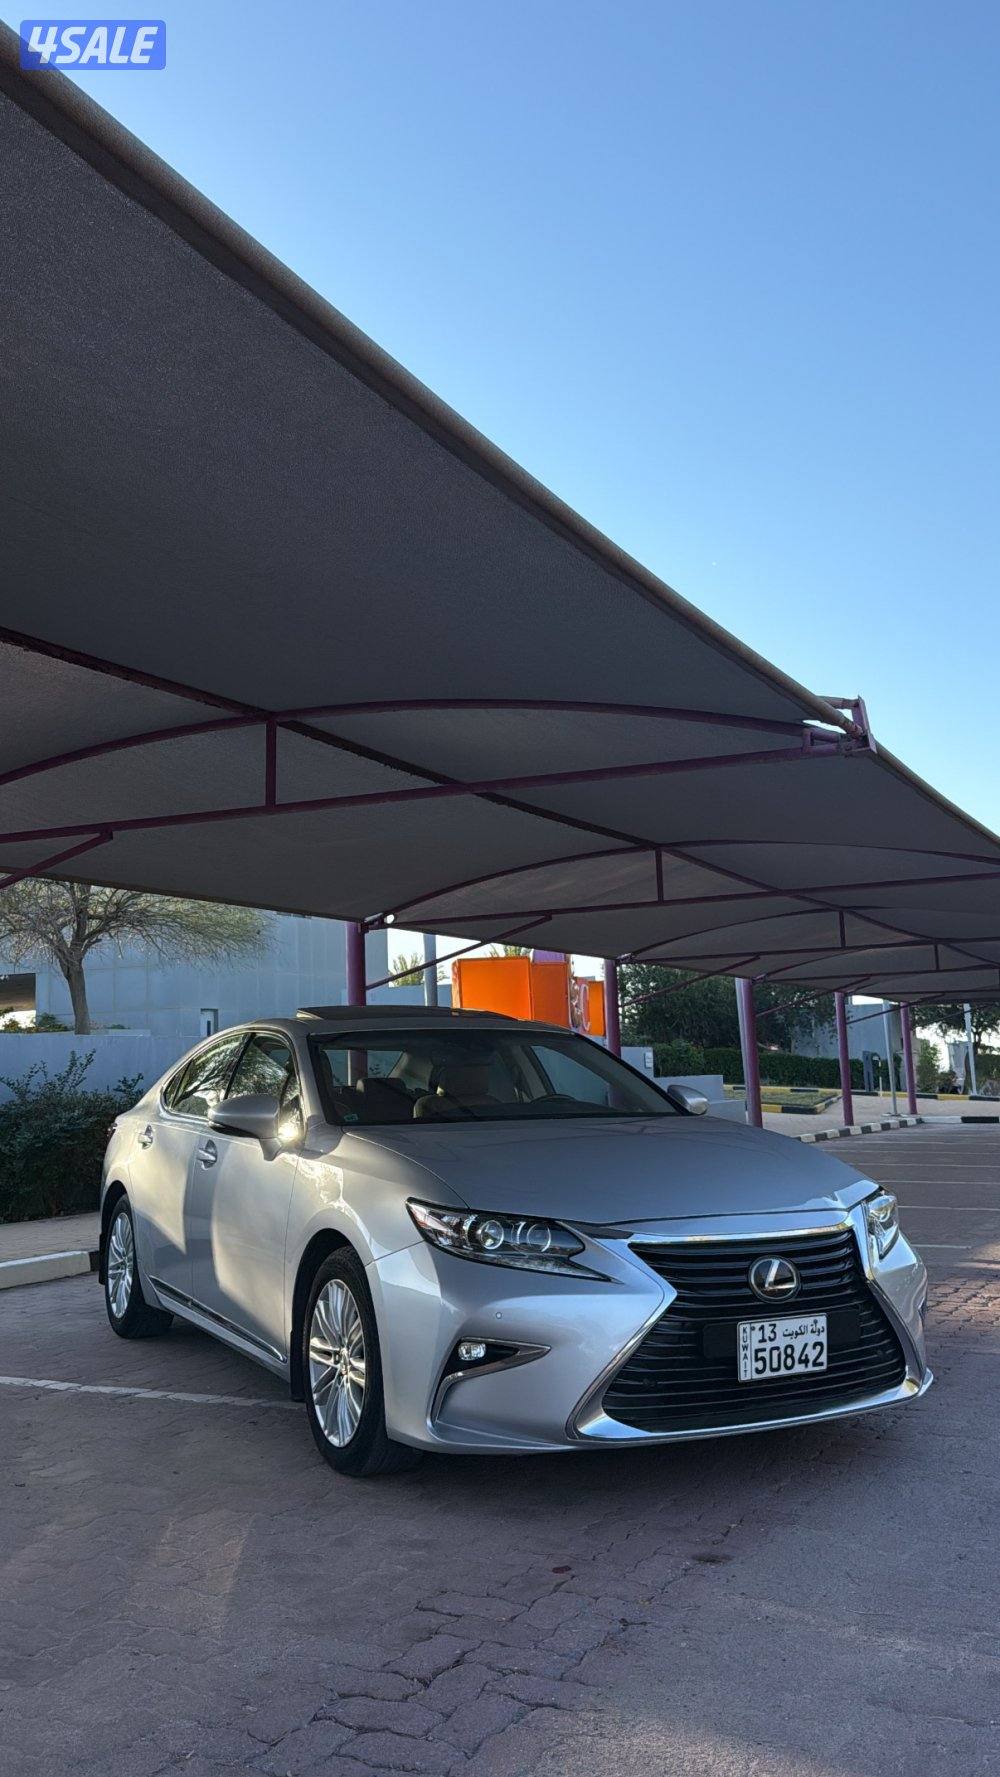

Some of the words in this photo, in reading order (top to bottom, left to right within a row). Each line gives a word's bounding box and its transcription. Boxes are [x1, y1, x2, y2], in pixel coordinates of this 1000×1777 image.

[758, 1323, 777, 1343] 13
[782, 1324, 809, 1339] الكويت
[810, 1322, 825, 1336] دولة
[754, 1341, 825, 1375] 50842
